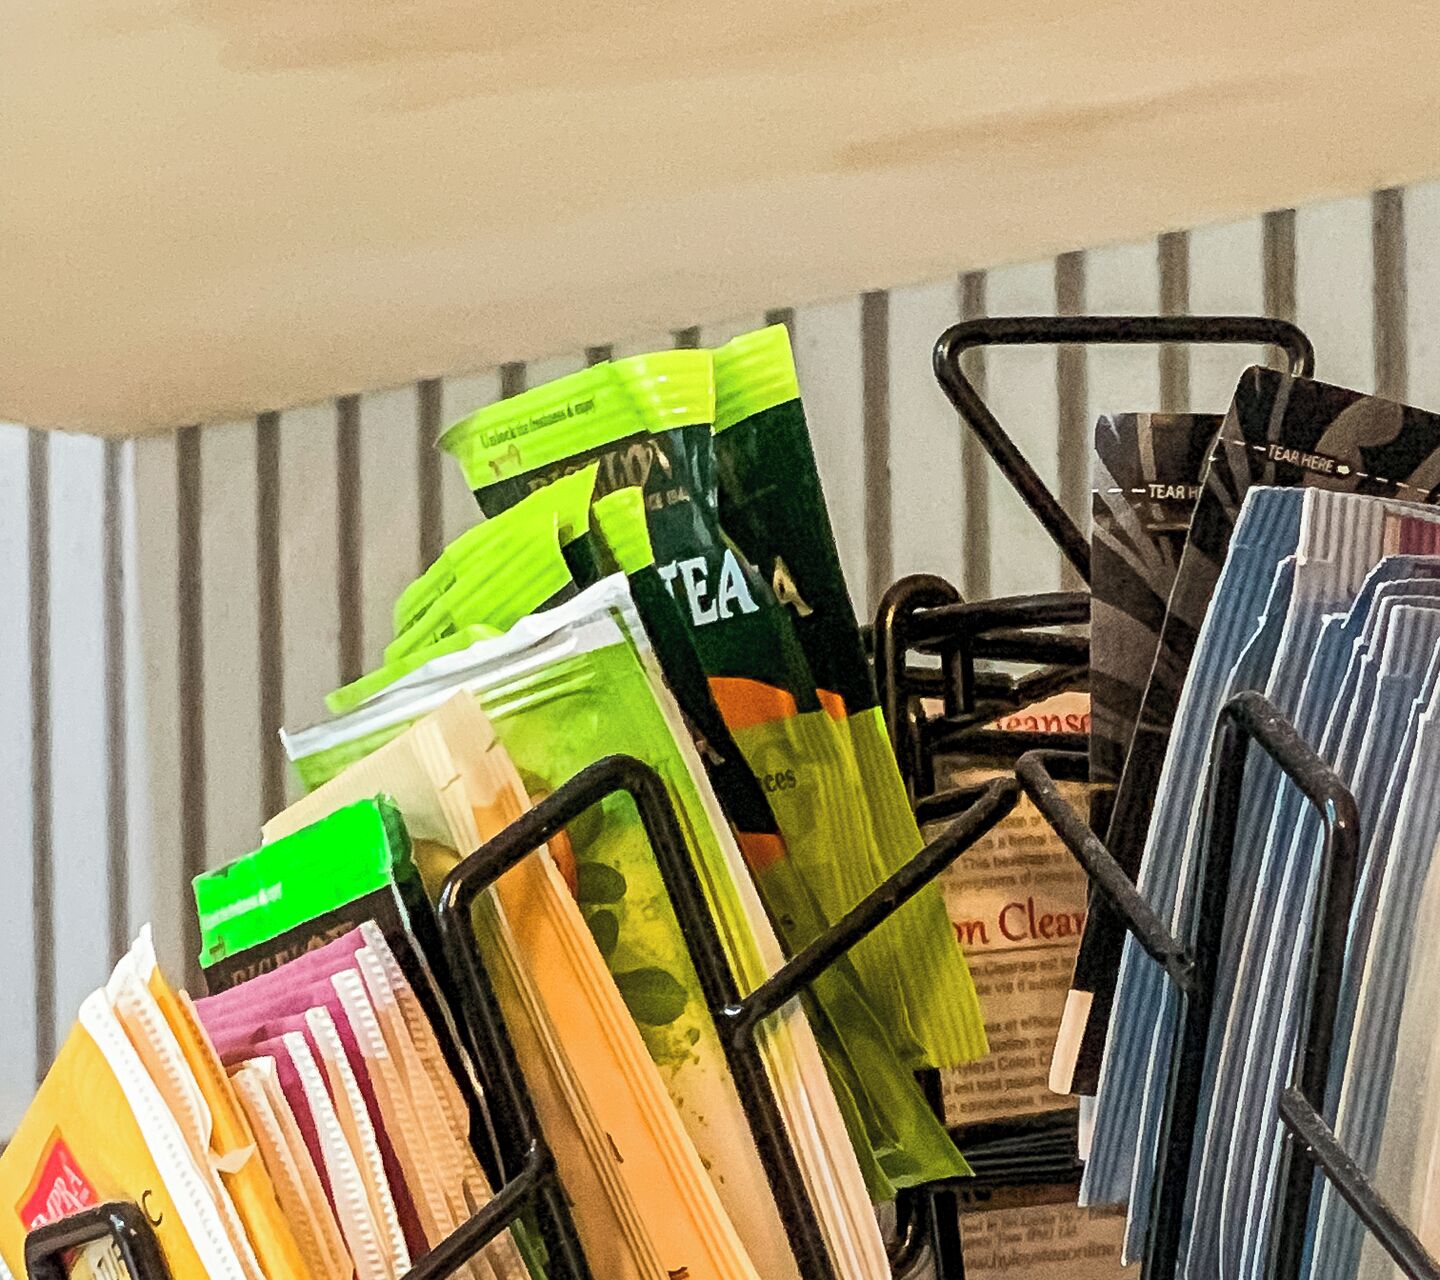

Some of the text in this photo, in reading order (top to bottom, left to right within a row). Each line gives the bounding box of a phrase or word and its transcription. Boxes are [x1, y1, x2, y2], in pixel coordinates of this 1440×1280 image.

[1268, 444, 1335, 473] TEAR HERE
[1148, 484, 1186, 500] TEAR
[657, 549, 760, 626] TEA
